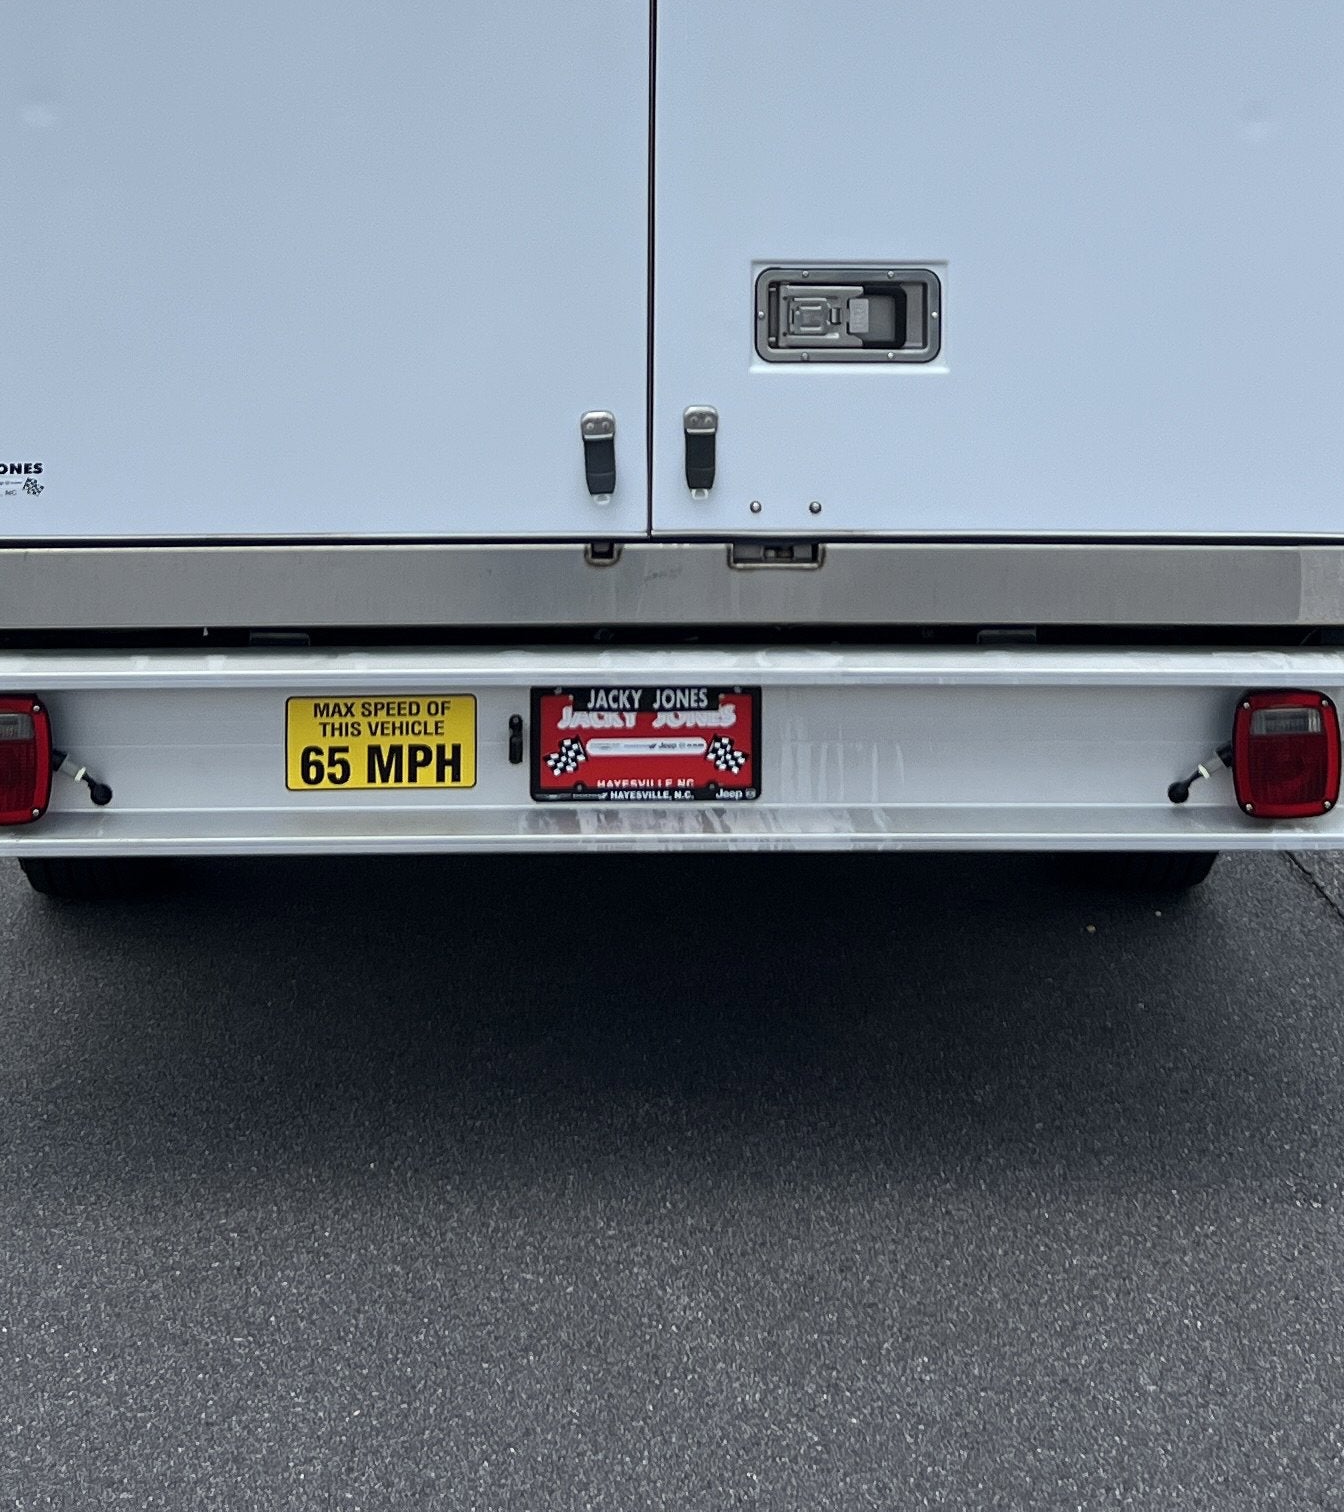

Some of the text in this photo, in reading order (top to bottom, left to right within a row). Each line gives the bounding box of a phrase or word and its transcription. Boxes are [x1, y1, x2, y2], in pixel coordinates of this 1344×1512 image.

[313, 700, 452, 718] MAX SPEED OF
[587, 688, 709, 710] JACKY JONES
[557, 703, 737, 729] JACKY JONES
[319, 720, 445, 737] THIS VEHICLE
[301, 743, 462, 785] 65 MPH
[715, 788, 743, 800] Jeep
